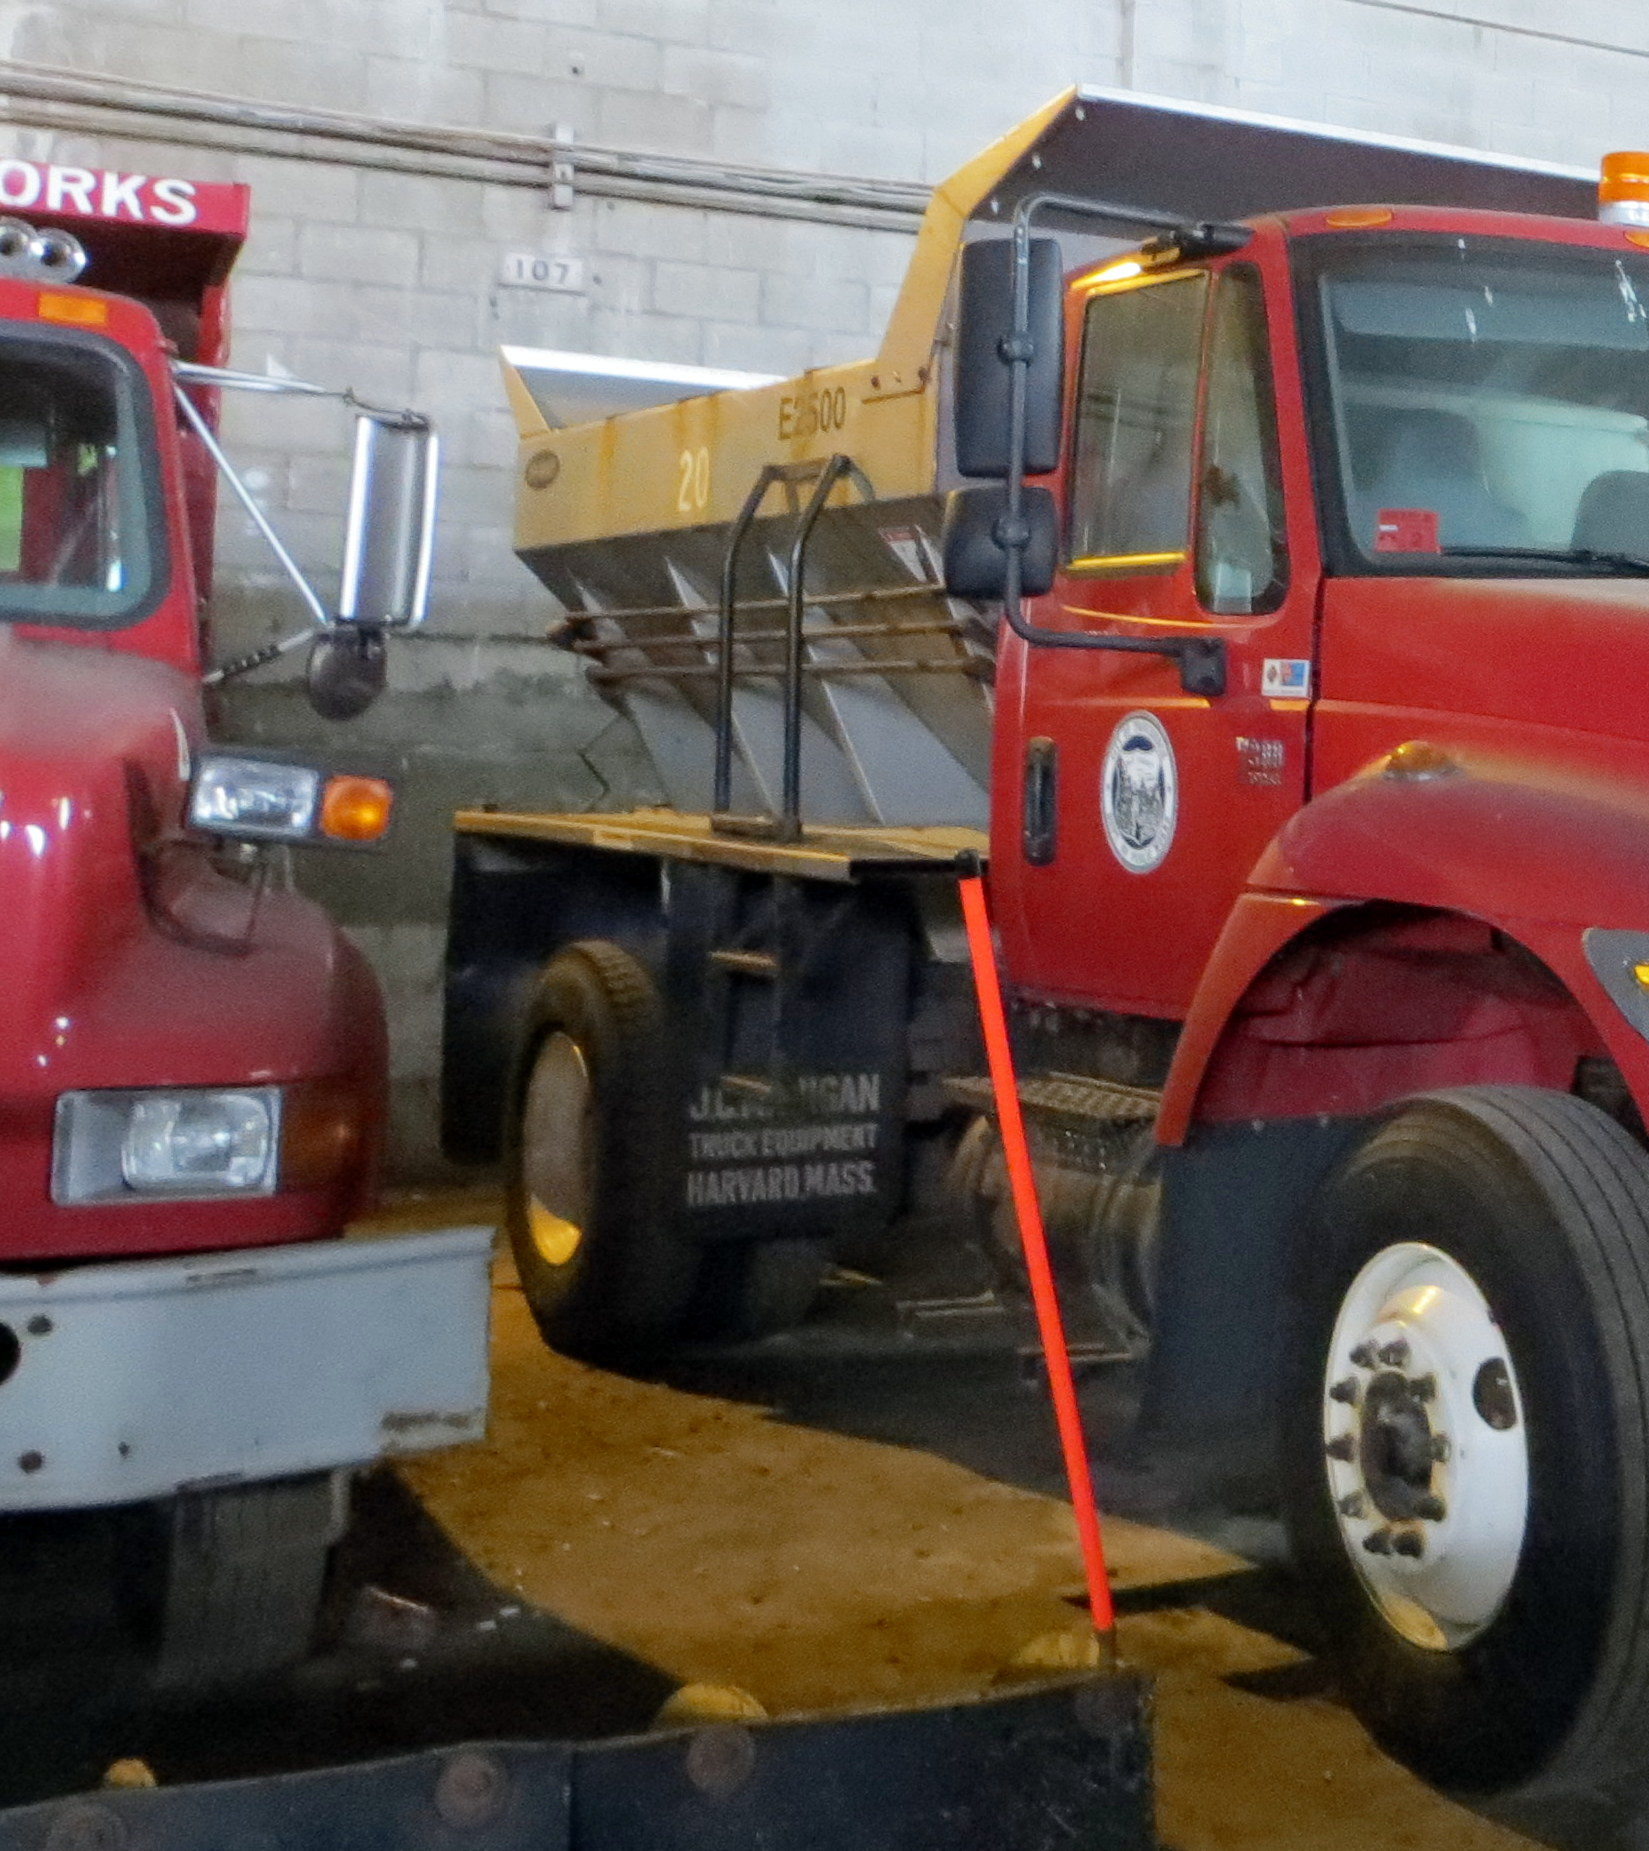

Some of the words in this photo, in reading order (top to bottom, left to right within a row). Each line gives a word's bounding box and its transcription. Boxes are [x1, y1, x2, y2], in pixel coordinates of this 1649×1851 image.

[0, 159, 198, 225] ORKS
[516, 259, 569, 284] 107
[677, 446, 710, 512] 20
[689, 1130, 757, 1159] TRUCK
[761, 1122, 878, 1156] EQUIPMENT
